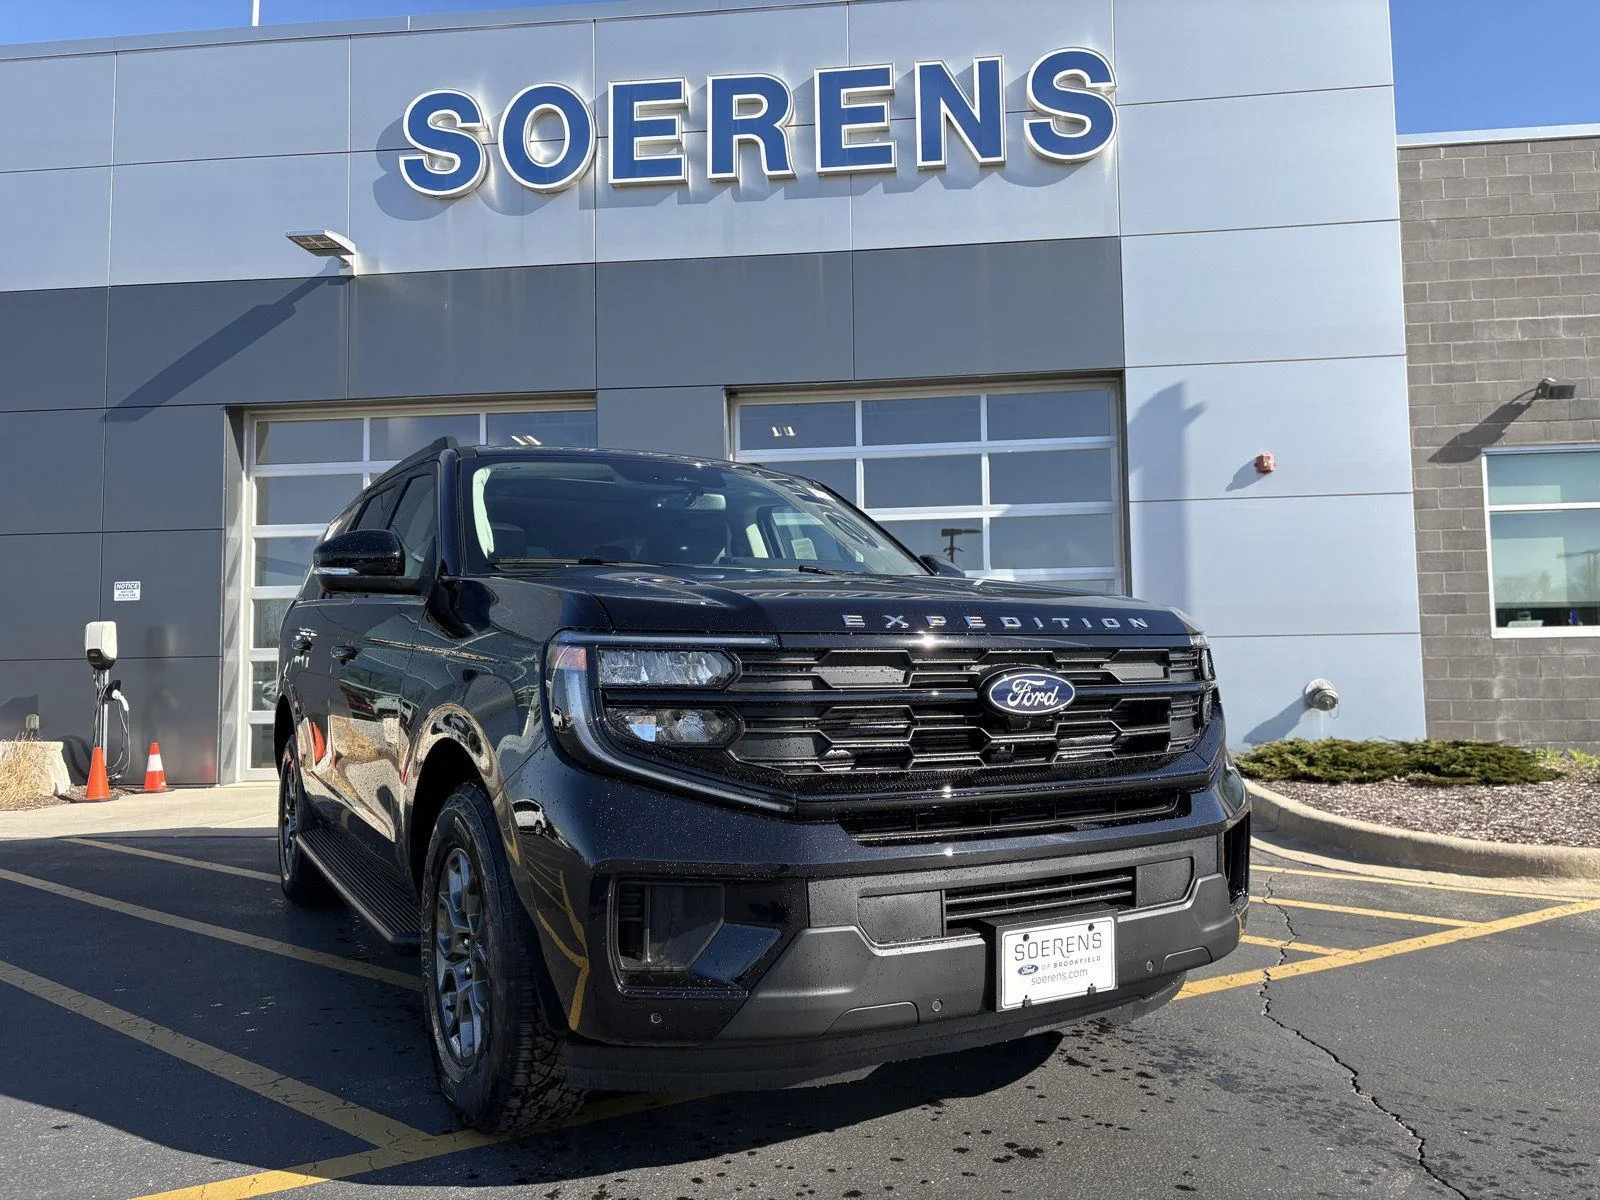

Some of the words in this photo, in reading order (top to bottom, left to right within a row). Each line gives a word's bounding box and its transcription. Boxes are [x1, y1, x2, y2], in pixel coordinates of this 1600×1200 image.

[399, 47, 1119, 199] SOERENS
[841, 614, 1149, 629] EXPEDITION
[1006, 677, 1060, 707] Ford
[1014, 932, 1102, 961] SOERENS
[1041, 963, 1051, 971] OF
[1053, 955, 1101, 969] BROOKFIELD
[1031, 968, 1088, 986] soerens.com
